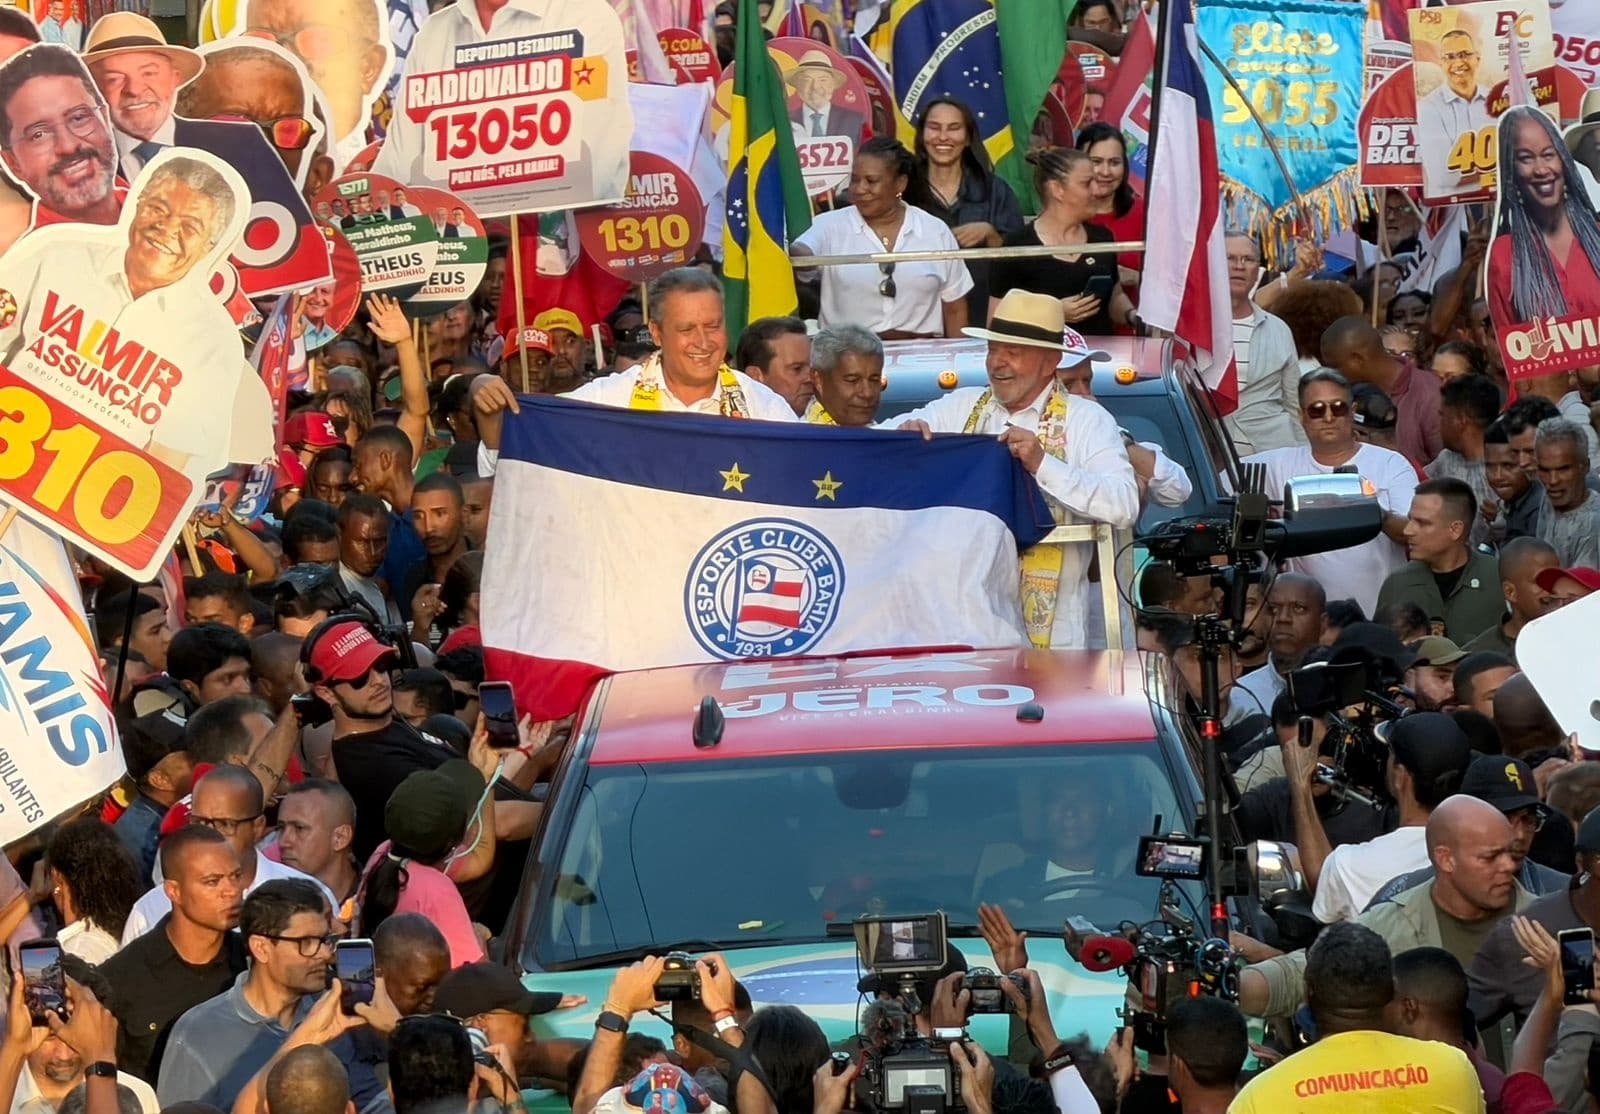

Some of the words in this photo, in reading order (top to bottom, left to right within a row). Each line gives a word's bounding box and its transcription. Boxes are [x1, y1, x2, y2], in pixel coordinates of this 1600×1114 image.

[1420, 10, 1442, 24] PSB
[456, 41, 516, 64] DEPUTADO
[517, 33, 576, 53] ESTADUAL
[671, 38, 703, 51] COM
[408, 57, 564, 109] RADIOVALDO
[1223, 79, 1339, 125] 5055
[430, 98, 571, 162] 13050
[451, 170, 473, 185] POR
[474, 164, 498, 183] NÓS,
[498, 162, 523, 179] PELA
[524, 156, 560, 173] BAHIA!
[598, 214, 690, 253] 1310
[368, 267, 426, 282] GERALDINHO
[39, 290, 181, 407] VALMIR
[1513, 356, 1568, 374] DEPUTADA
[26, 336, 162, 425] ASSUNÇÃO
[87, 399, 132, 429] FEDERAL
[697, 534, 754, 627] ESPORTE
[761, 530, 827, 571] CLUBE
[800, 573, 834, 635] BAHIA
[735, 642, 772, 656] 1931
[719, 684, 1035, 719] JERO
[1295, 1063, 1429, 1098] COMUNICAÇÃO
